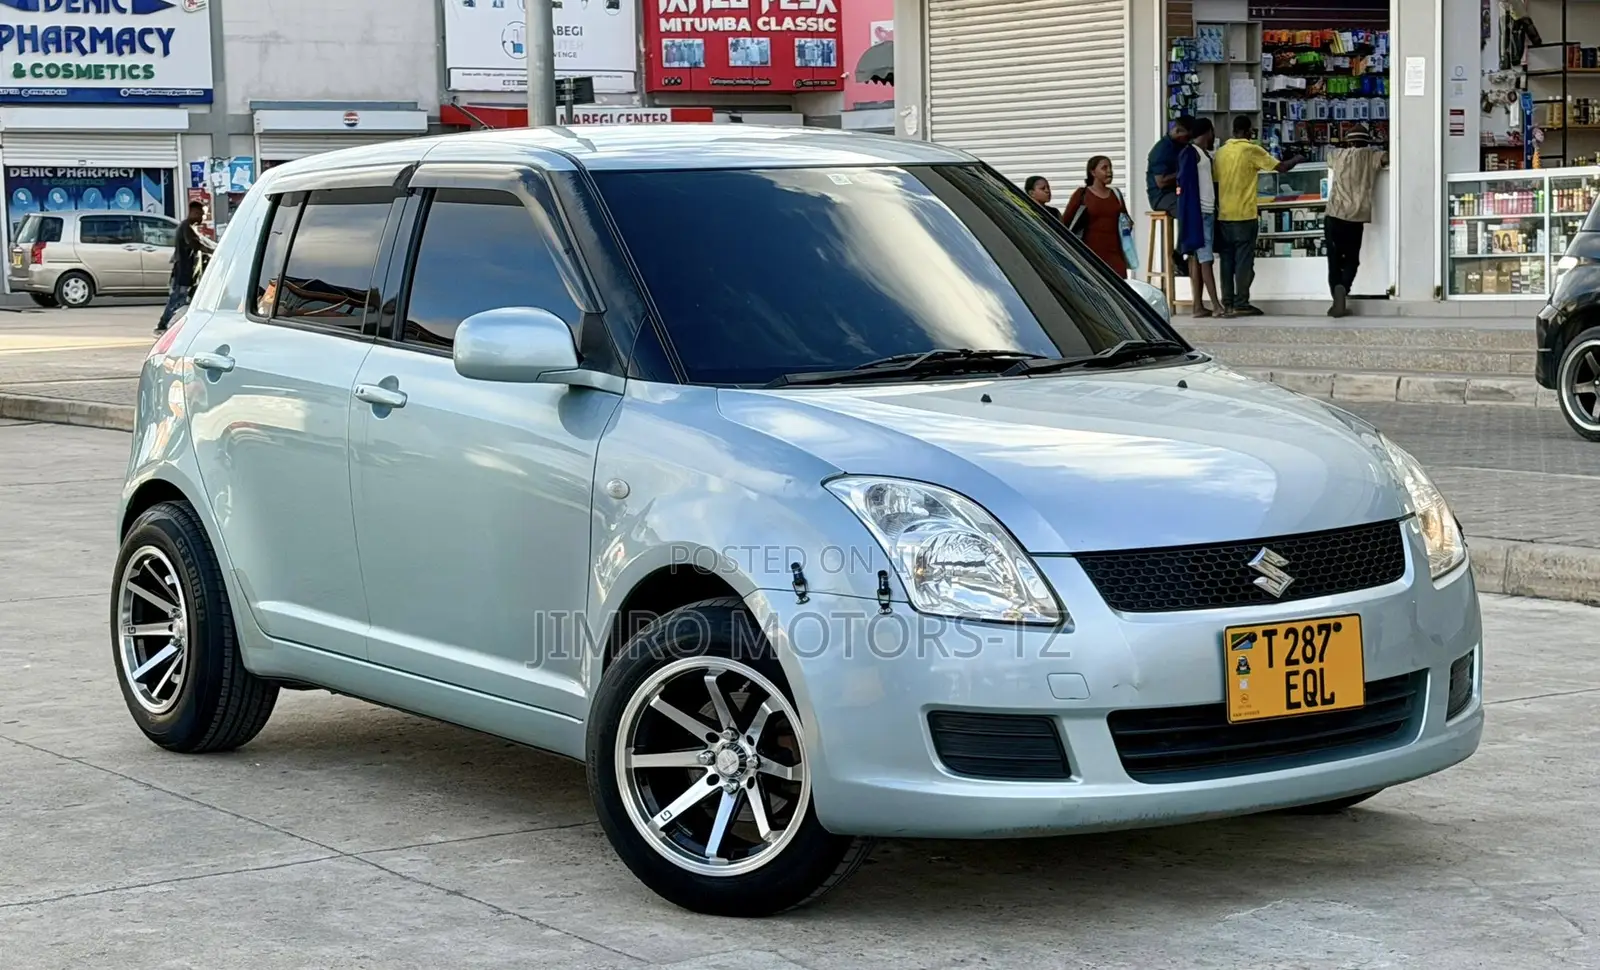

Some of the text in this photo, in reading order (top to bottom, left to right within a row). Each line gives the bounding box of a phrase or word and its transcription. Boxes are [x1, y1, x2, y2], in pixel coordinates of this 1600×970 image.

[659, 16, 837, 32] MITUMBA CLASSIC
[0, 24, 176, 57] PHARMACY
[12, 63, 155, 80] & COSMETICS
[617, 113, 668, 123] CENTER
[9, 167, 136, 178] DENIC PHARMACY
[1262, 622, 1332, 668] T 287
[1286, 668, 1335, 710] EQL
